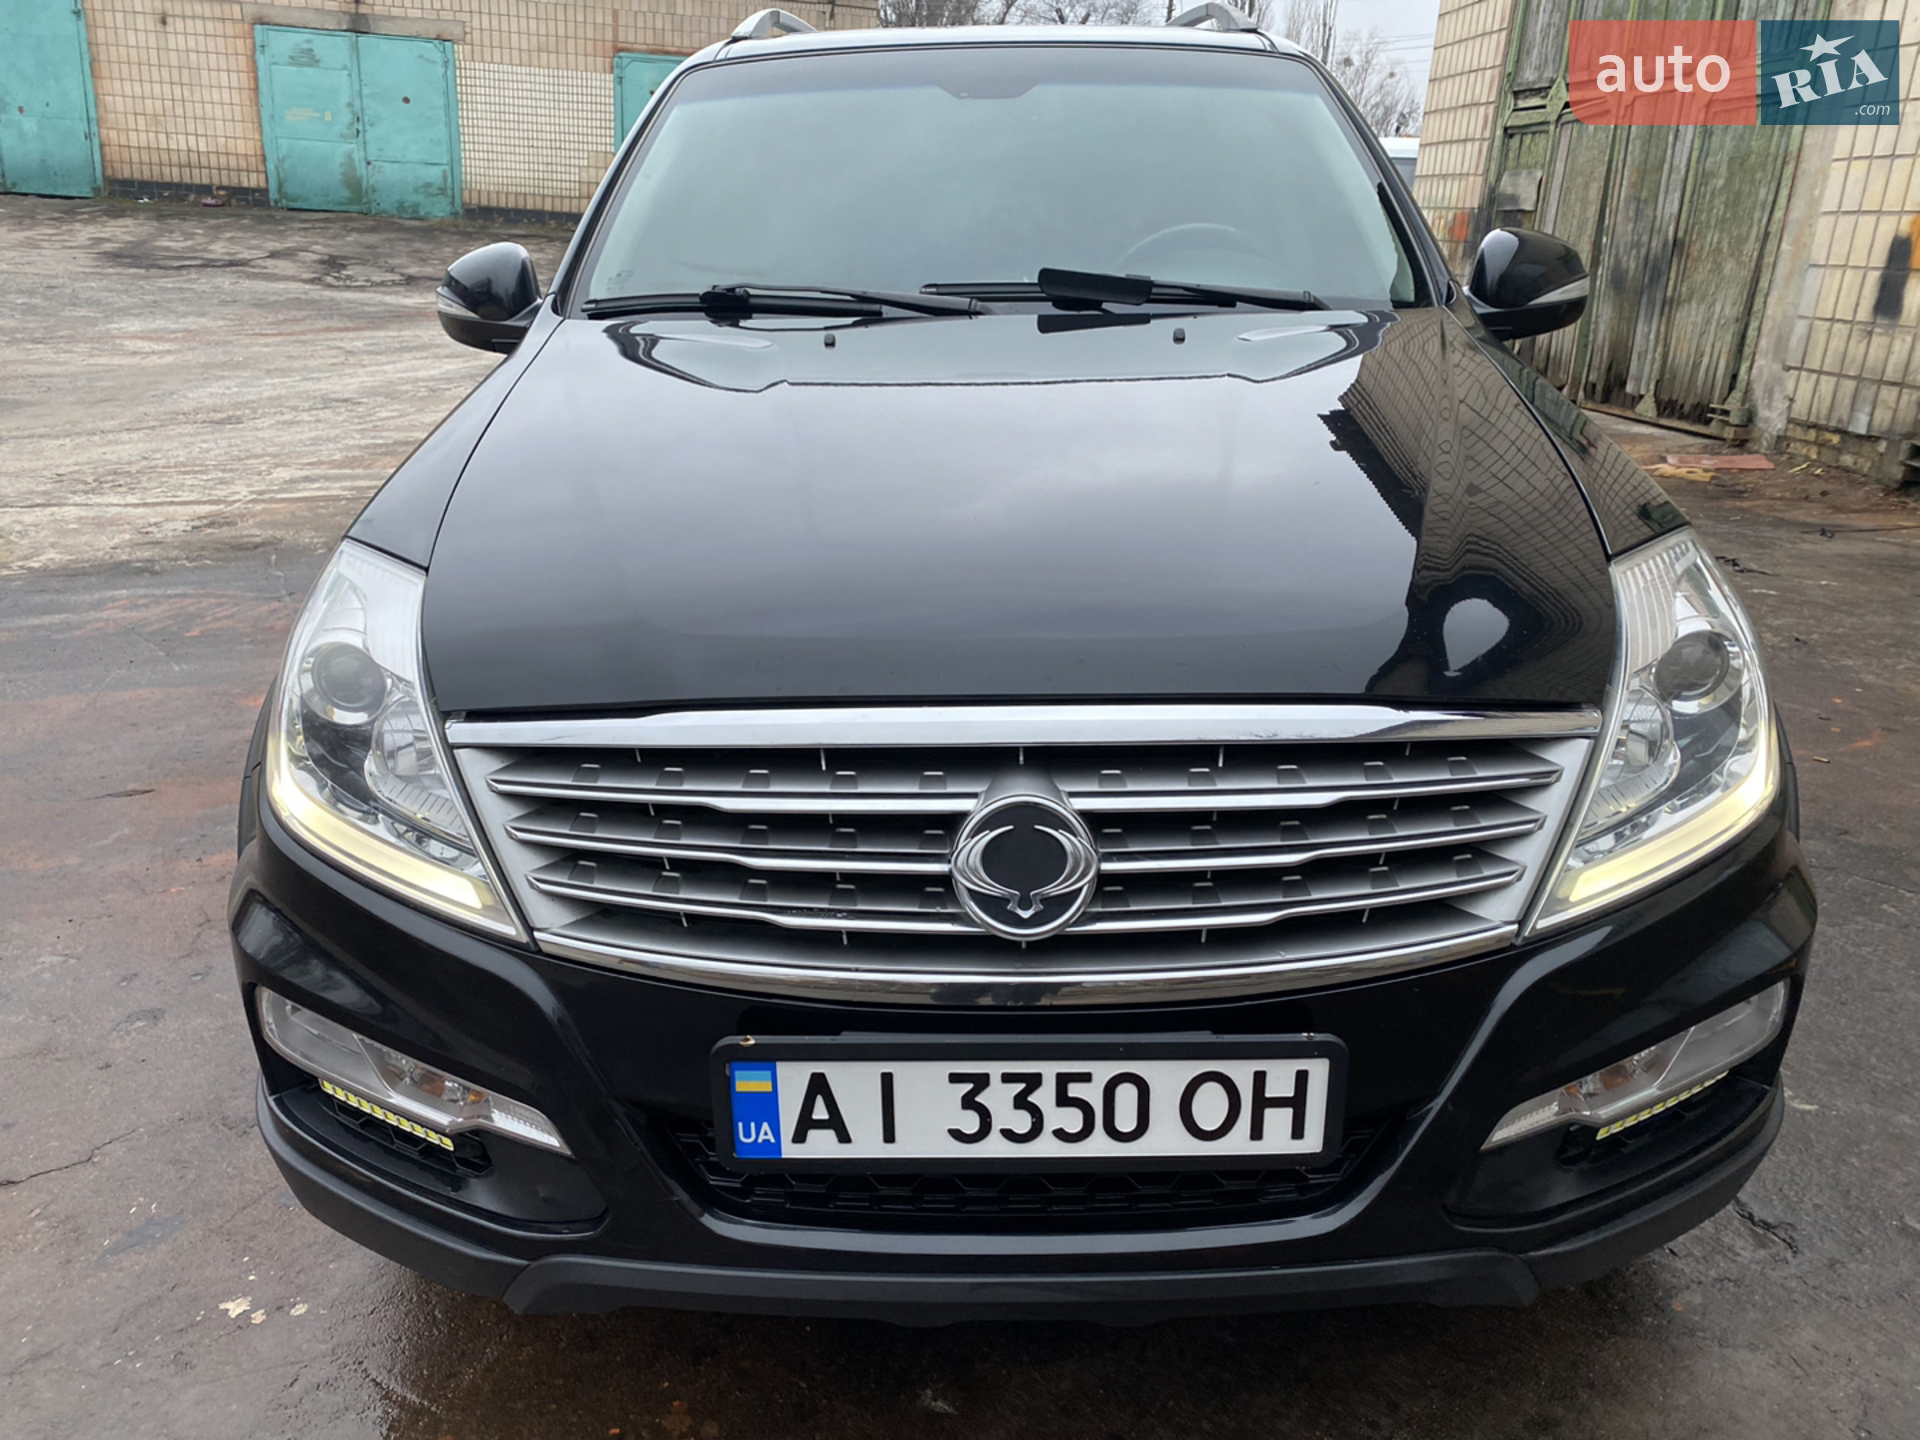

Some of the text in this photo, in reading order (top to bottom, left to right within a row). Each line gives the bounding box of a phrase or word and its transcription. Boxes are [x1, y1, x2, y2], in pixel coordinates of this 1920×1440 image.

[946, 1070, 1151, 1144] 3350
[1178, 1069, 1309, 1142] OH
[737, 1121, 776, 1144] UA
